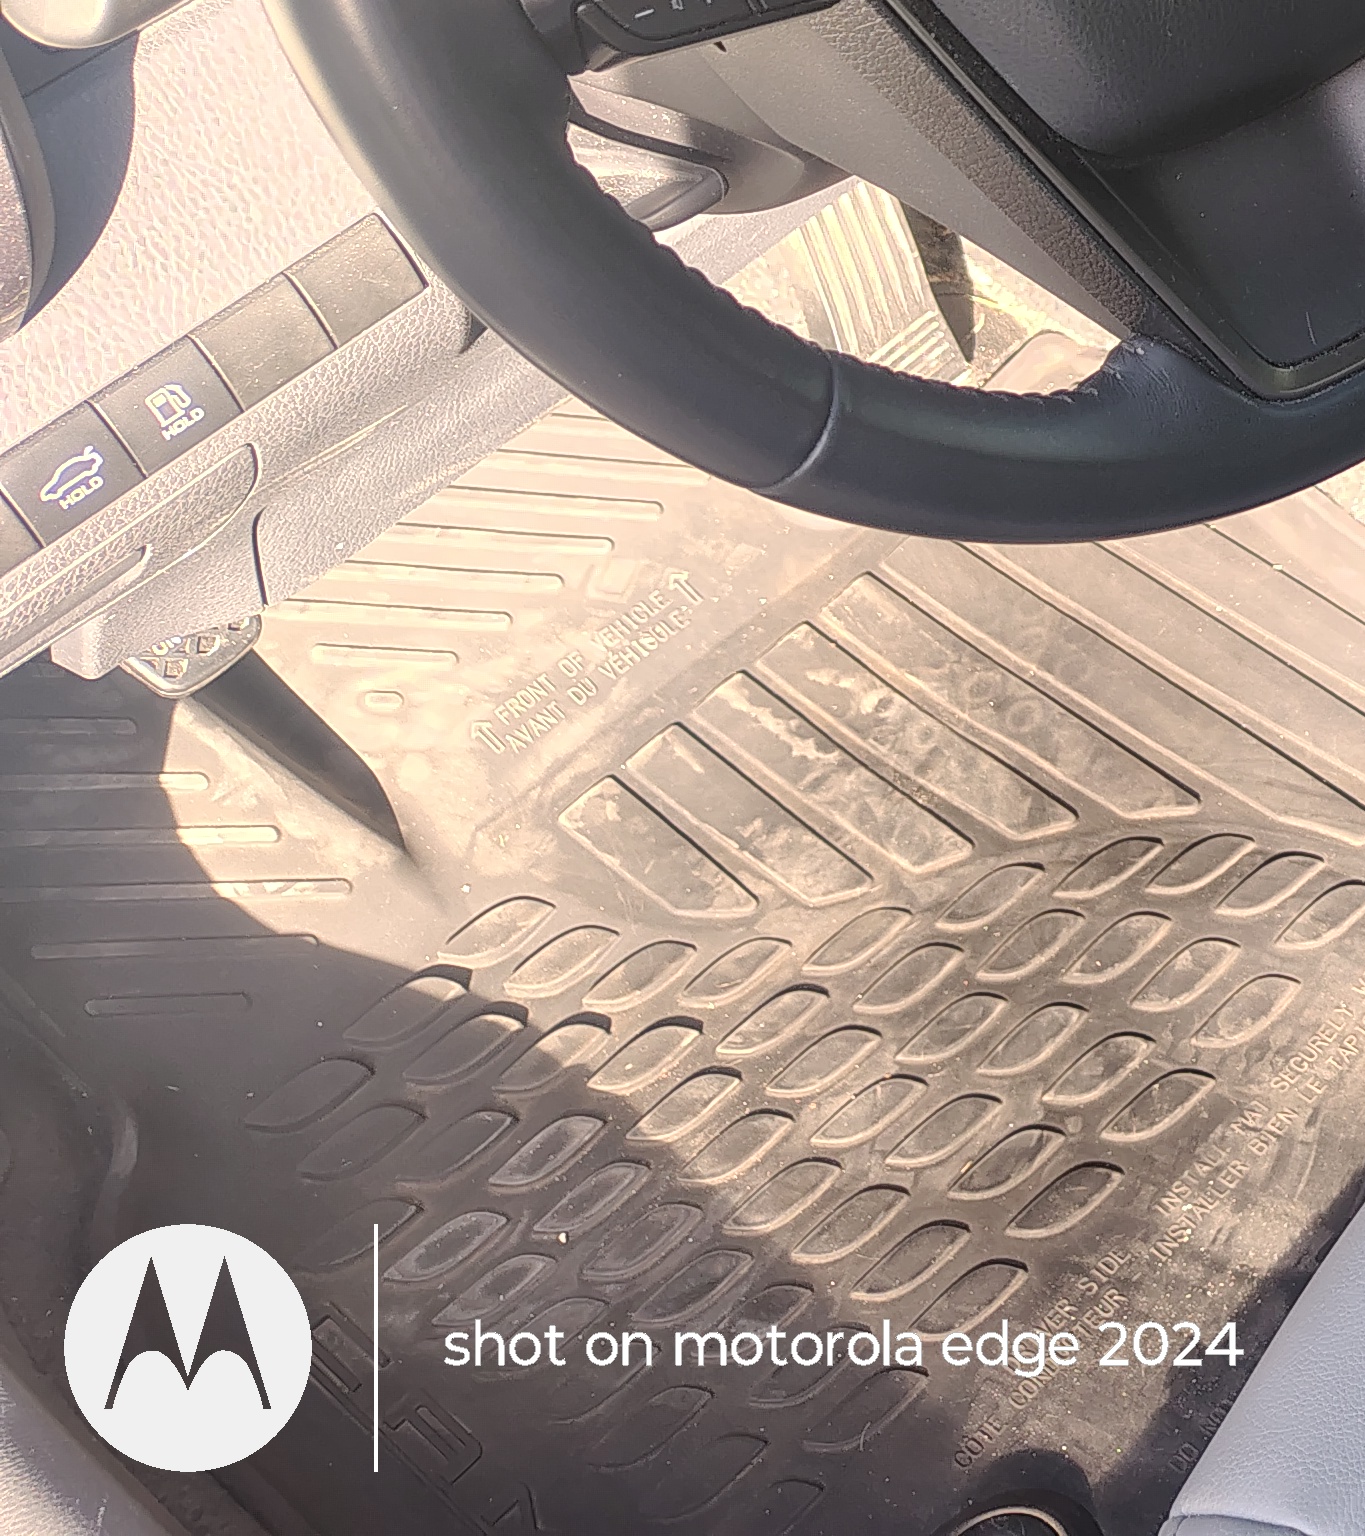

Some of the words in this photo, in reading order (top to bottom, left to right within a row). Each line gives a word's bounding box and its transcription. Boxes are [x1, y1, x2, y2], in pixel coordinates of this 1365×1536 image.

[160, 407, 205, 441] HOLD
[58, 475, 104, 510] HOLD
[493, 672, 557, 726] FRONT
[557, 649, 585, 678] OF
[590, 589, 674, 652] VEHICLE
[505, 699, 566, 755] AVANT
[567, 677, 600, 706] DU
[1077, 1247, 1132, 1296] SIDE
[1271, 1000, 1357, 1093] SECURELY
[1150, 1160, 1250, 1262] INSTALLER
[1249, 1107, 1299, 1156] BIEN
[1299, 1072, 1328, 1104] LE
